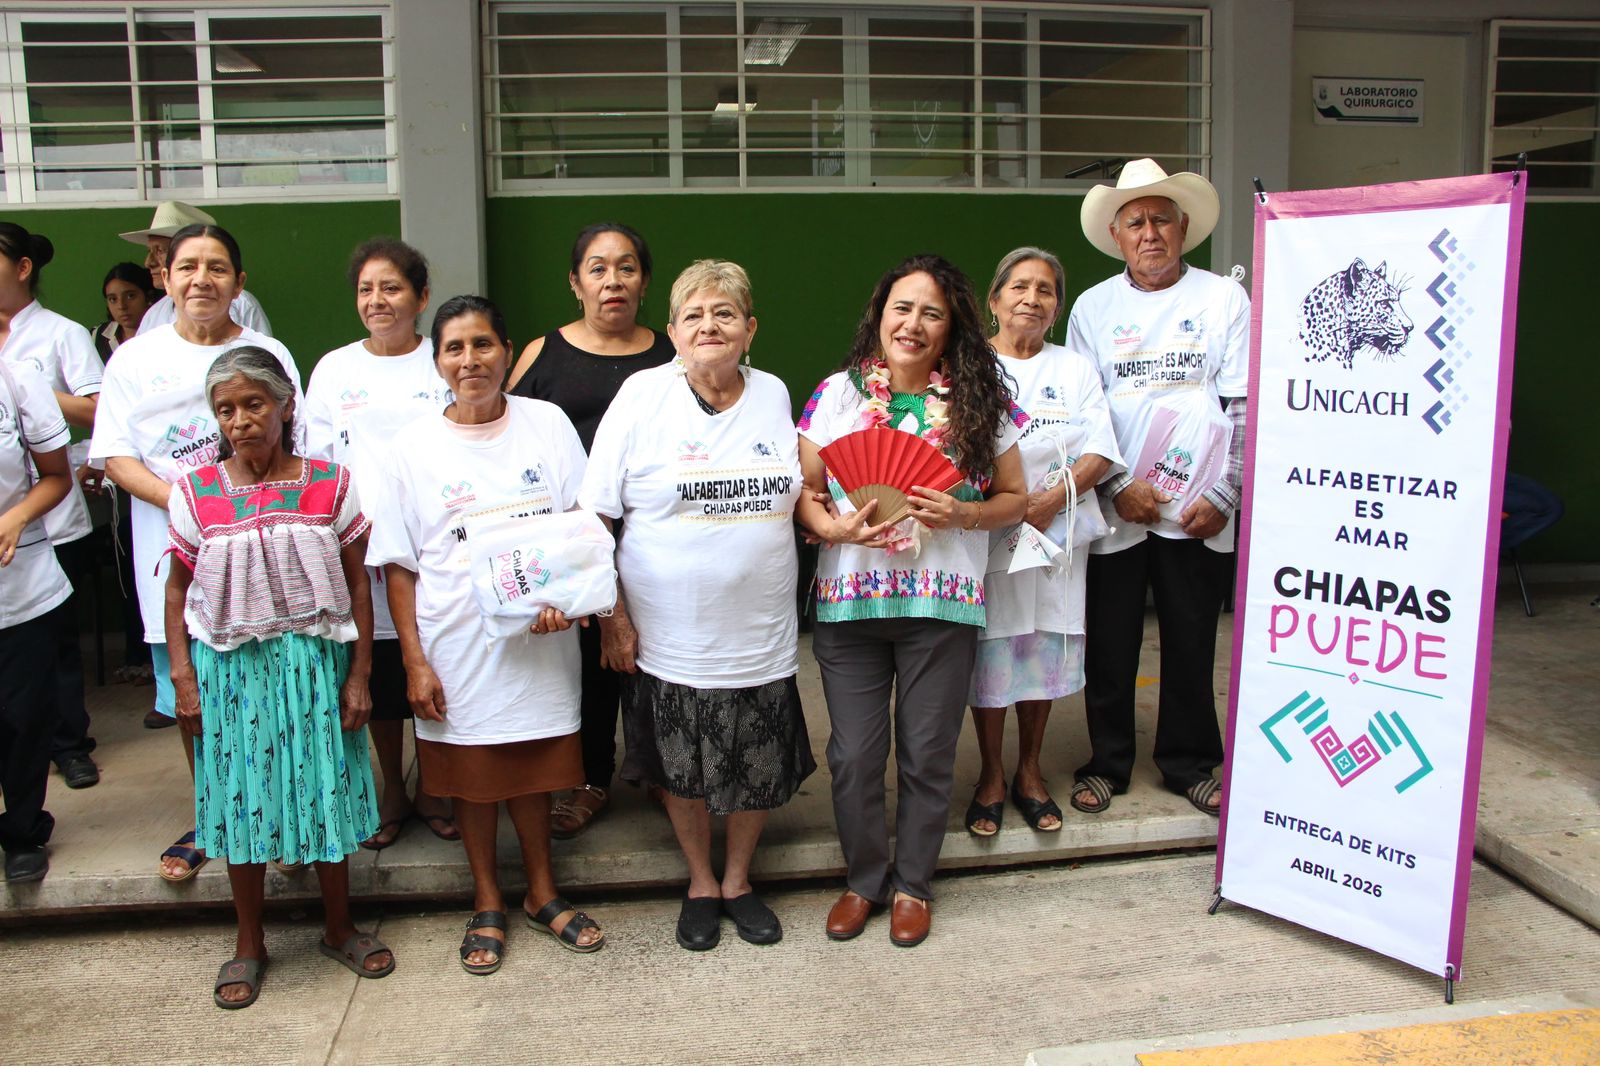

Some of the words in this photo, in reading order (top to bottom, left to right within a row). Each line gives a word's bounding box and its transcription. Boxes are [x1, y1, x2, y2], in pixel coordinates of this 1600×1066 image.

[1340, 87, 1418, 98] LABORATORIO
[1343, 98, 1414, 109] QUIRURGICO
[1165, 352, 1176, 368] ES
[1161, 371, 1186, 381] PUEDE
[171, 432, 220, 459] CHIAPAS
[1154, 462, 1190, 482] CHIPAS
[1286, 466, 1458, 500] ALFABETIZAR
[676, 479, 746, 501] "ALFABETIZAR
[748, 477, 760, 497] ES
[762, 476, 793, 496] AMOR"
[703, 502, 742, 515] CHIAPAS
[743, 500, 772, 512] PUEDE
[1355, 500, 1384, 519] ES
[1335, 525, 1409, 551] AMAR
[497, 552, 520, 602] PUEDE
[512, 549, 531, 596] CHIAPAS
[1273, 566, 1452, 624] CHIAPAS
[1268, 604, 1448, 680] PUEDE
[1263, 810, 1344, 846] ENTREGA
[1348, 834, 1372, 855] DE
[1376, 843, 1417, 869] KITS
[1290, 857, 1339, 884] ABRIL
[1342, 873, 1383, 898] 2026
